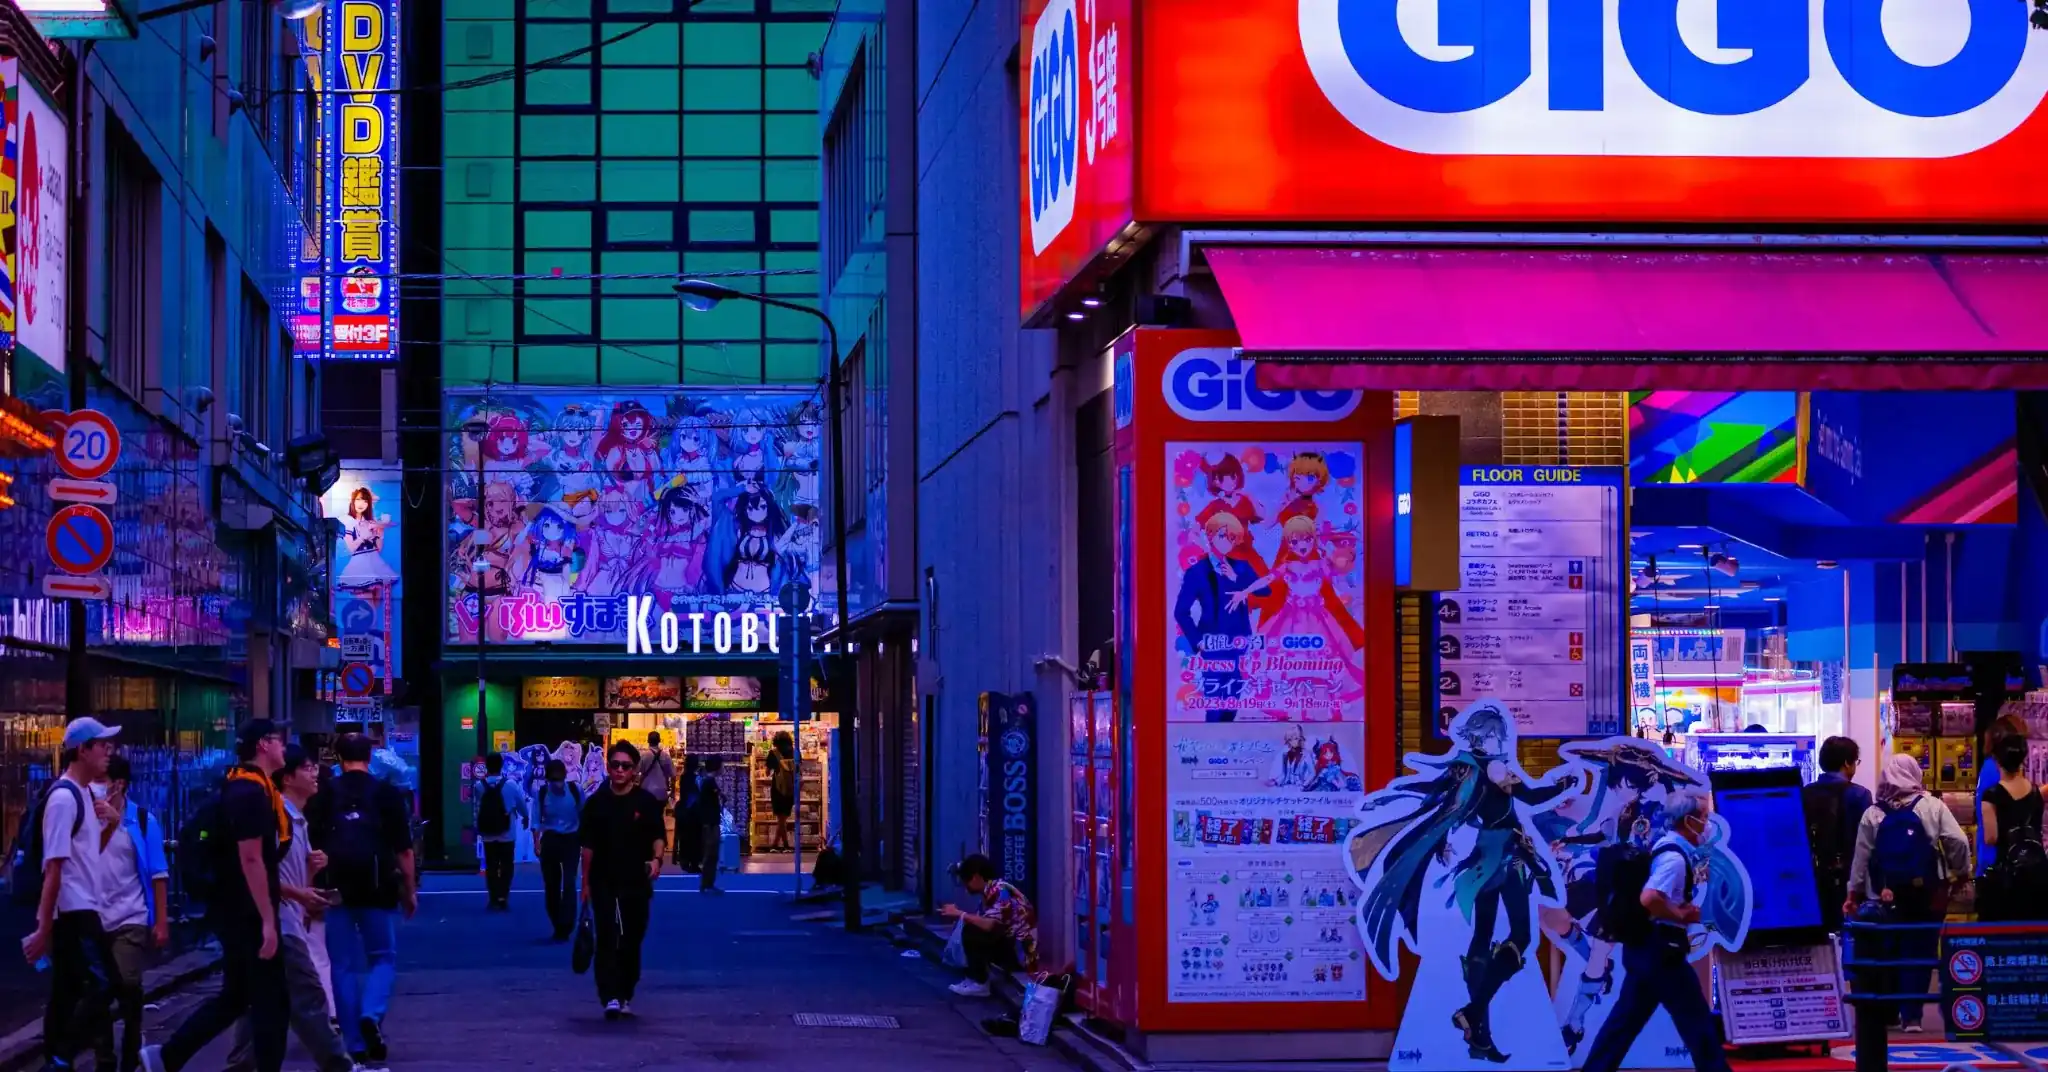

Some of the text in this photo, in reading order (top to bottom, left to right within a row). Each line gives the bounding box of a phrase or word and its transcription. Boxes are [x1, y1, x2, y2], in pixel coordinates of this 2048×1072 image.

[341, 2, 384, 262] DVD鑑賞
[67, 430, 106, 460] 20
[1472, 469, 1582, 482] FLOOR GUIDE
[1188, 656, 1345, 673] Dress Up Blooming
[1439, 677, 1459, 690] 2F
[1631, 644, 1651, 699] 両替機
[1003, 760, 1027, 830] BOSS
[1004, 835, 1013, 881] SUNTORY
[1014, 834, 1025, 881] COFFEE
